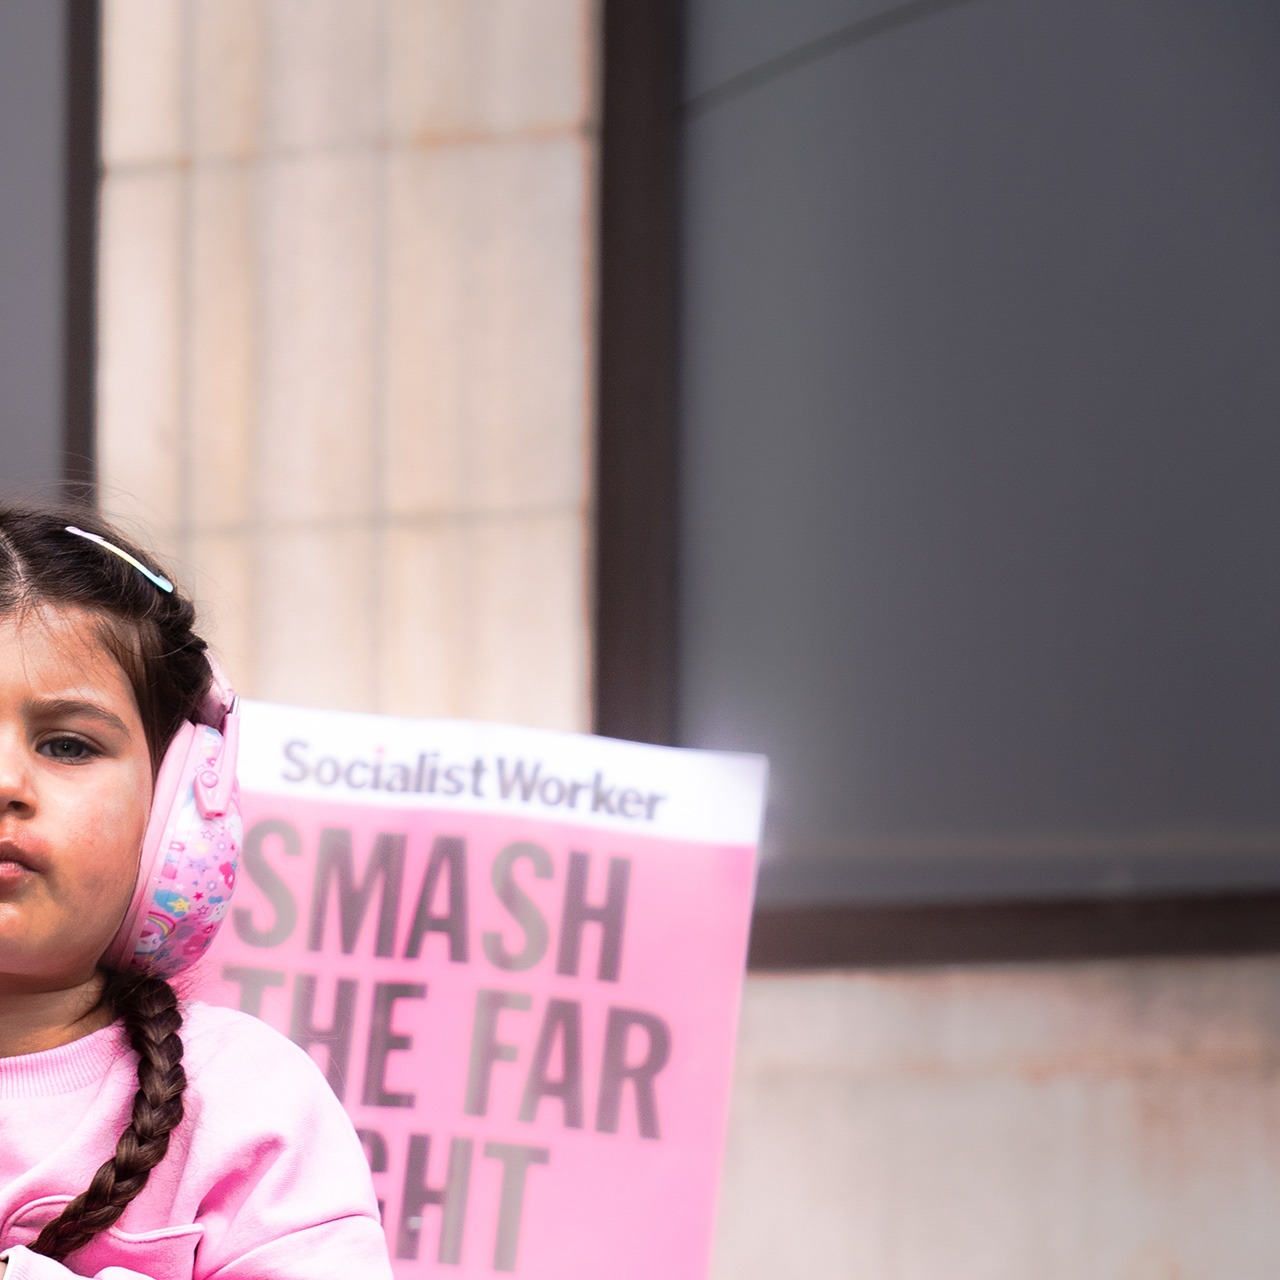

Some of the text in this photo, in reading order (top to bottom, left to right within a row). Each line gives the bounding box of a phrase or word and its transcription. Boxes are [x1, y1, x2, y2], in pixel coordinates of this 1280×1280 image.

[281, 739, 668, 821] Socialist Worker
[231, 818, 632, 984] SMASH
[462, 987, 673, 1140] FAR
